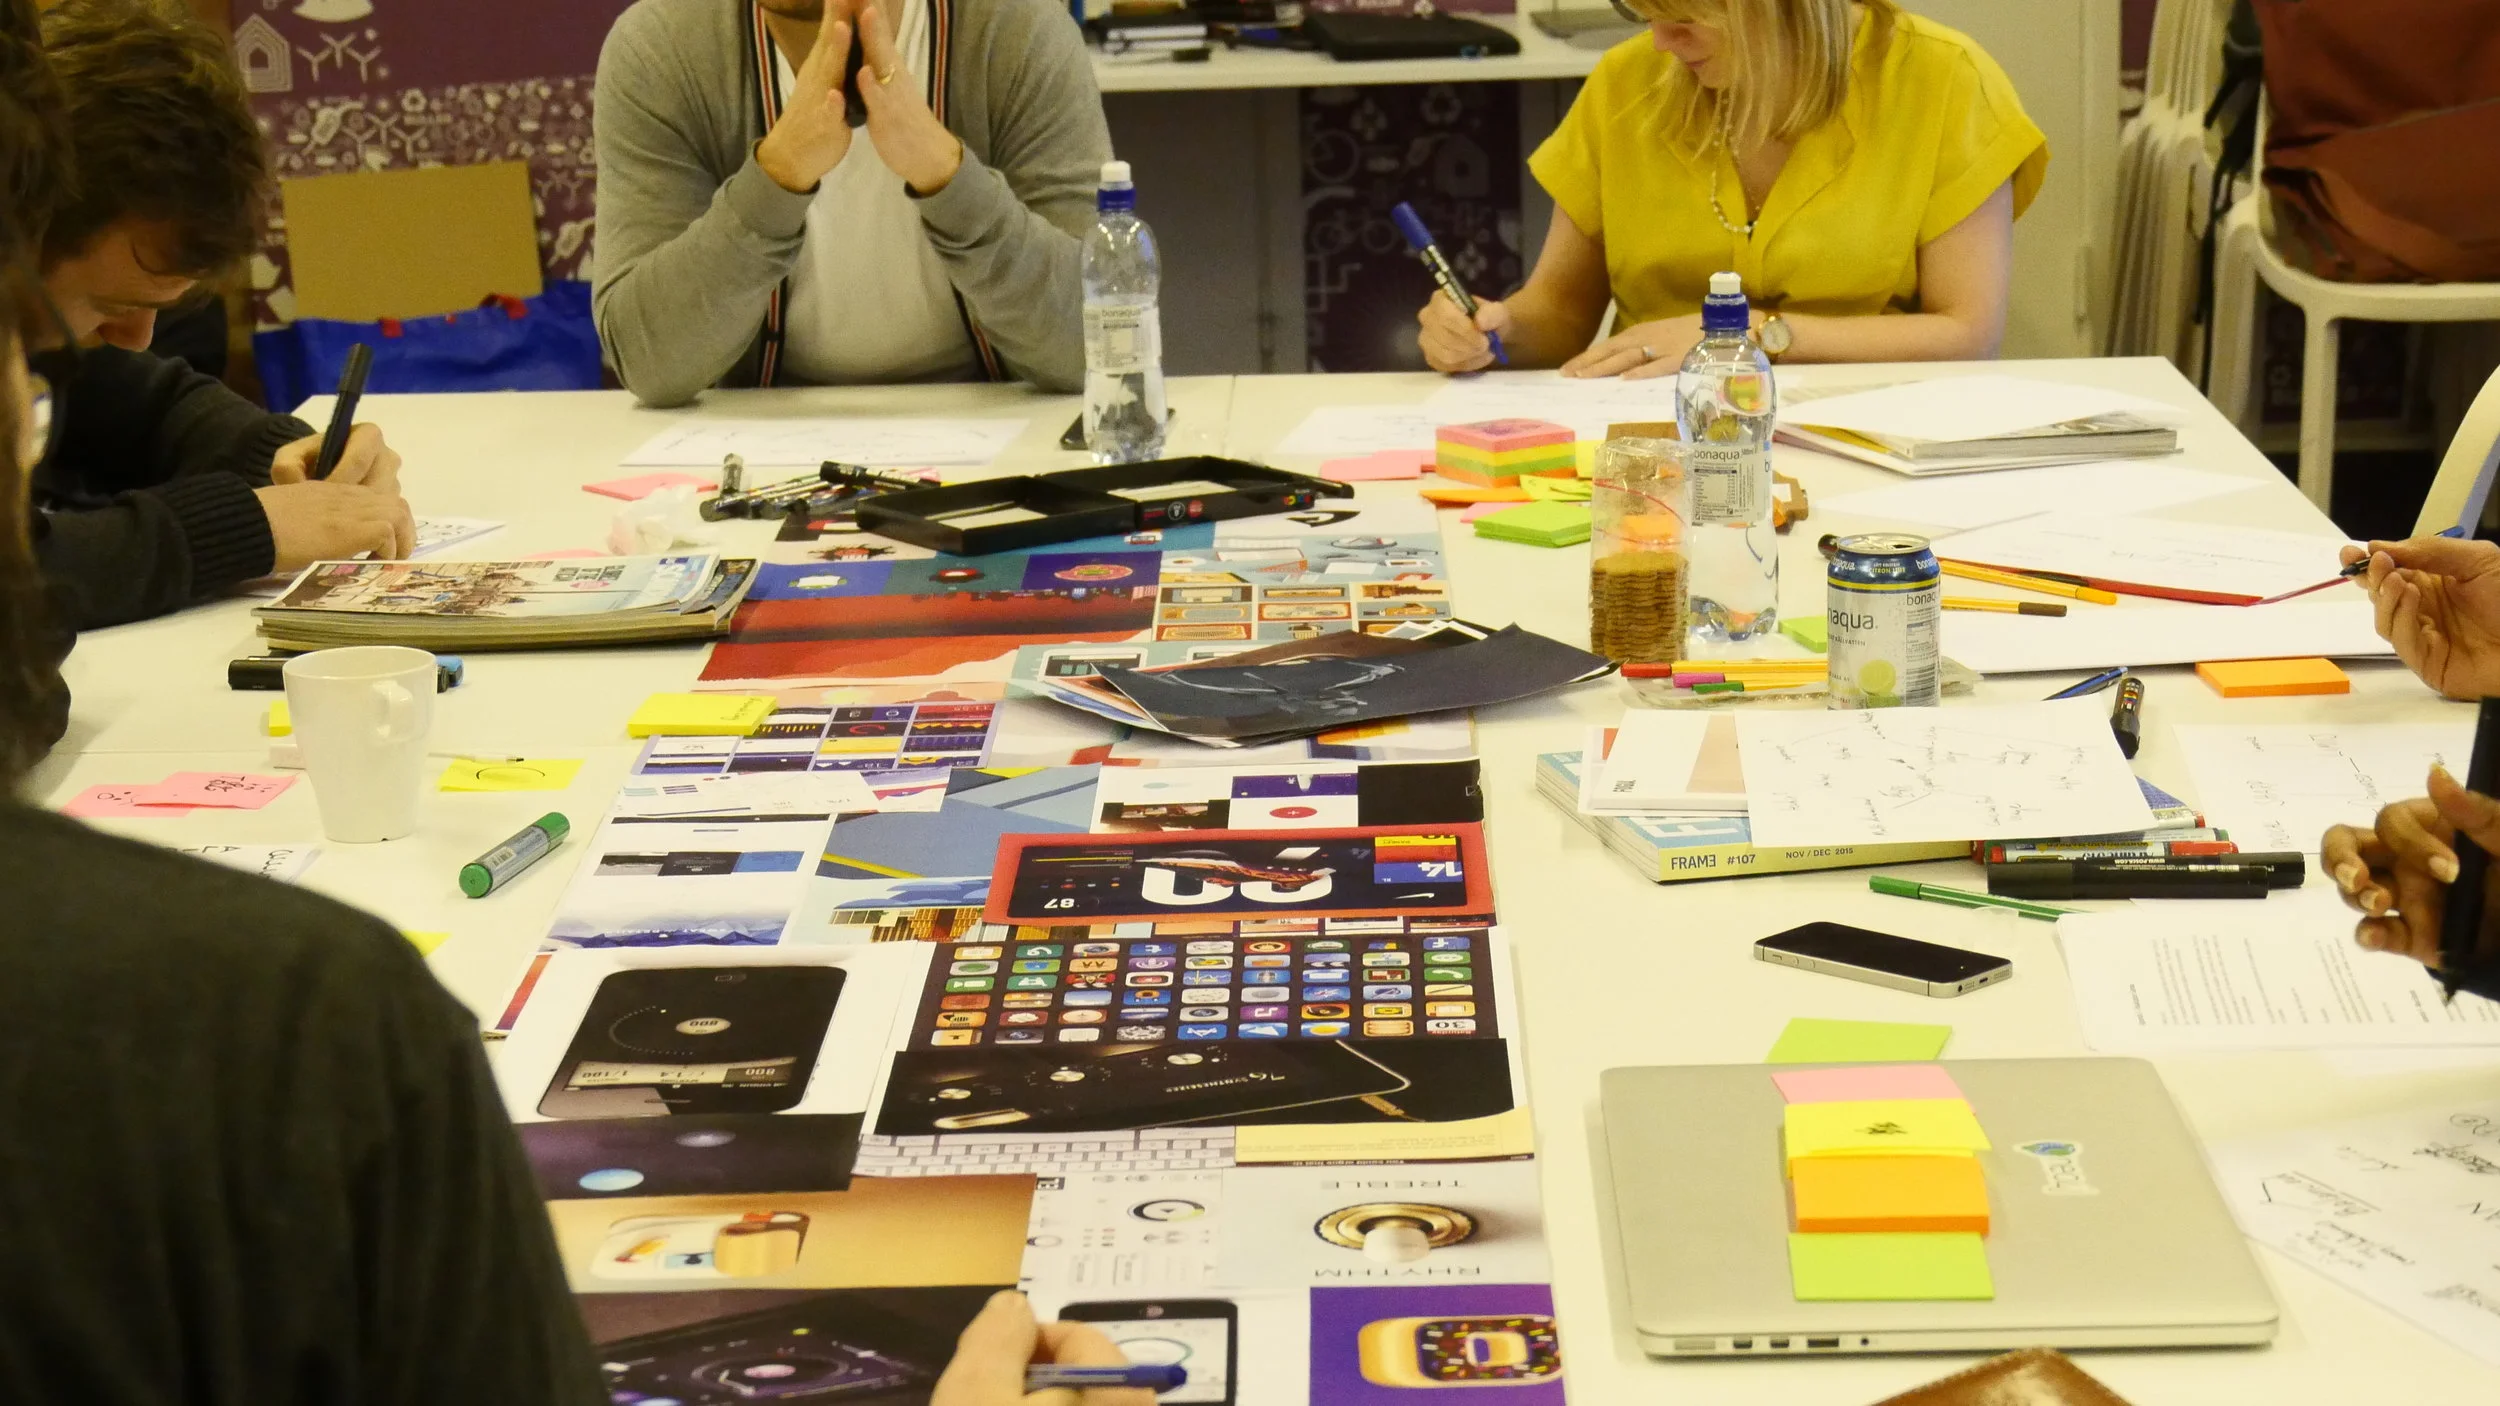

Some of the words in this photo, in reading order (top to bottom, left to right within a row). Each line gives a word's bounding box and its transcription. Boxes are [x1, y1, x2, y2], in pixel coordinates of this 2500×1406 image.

[1785, 851, 1805, 859] NOV
[1813, 849, 1831, 857] DEC
[1835, 847, 1854, 856] 2015
[1727, 854, 1756, 865] #107
[1417, 861, 1463, 877] 14
[1320, 1179, 1466, 1190] TREBLE
[1314, 1265, 1480, 1278] RHYTHM
